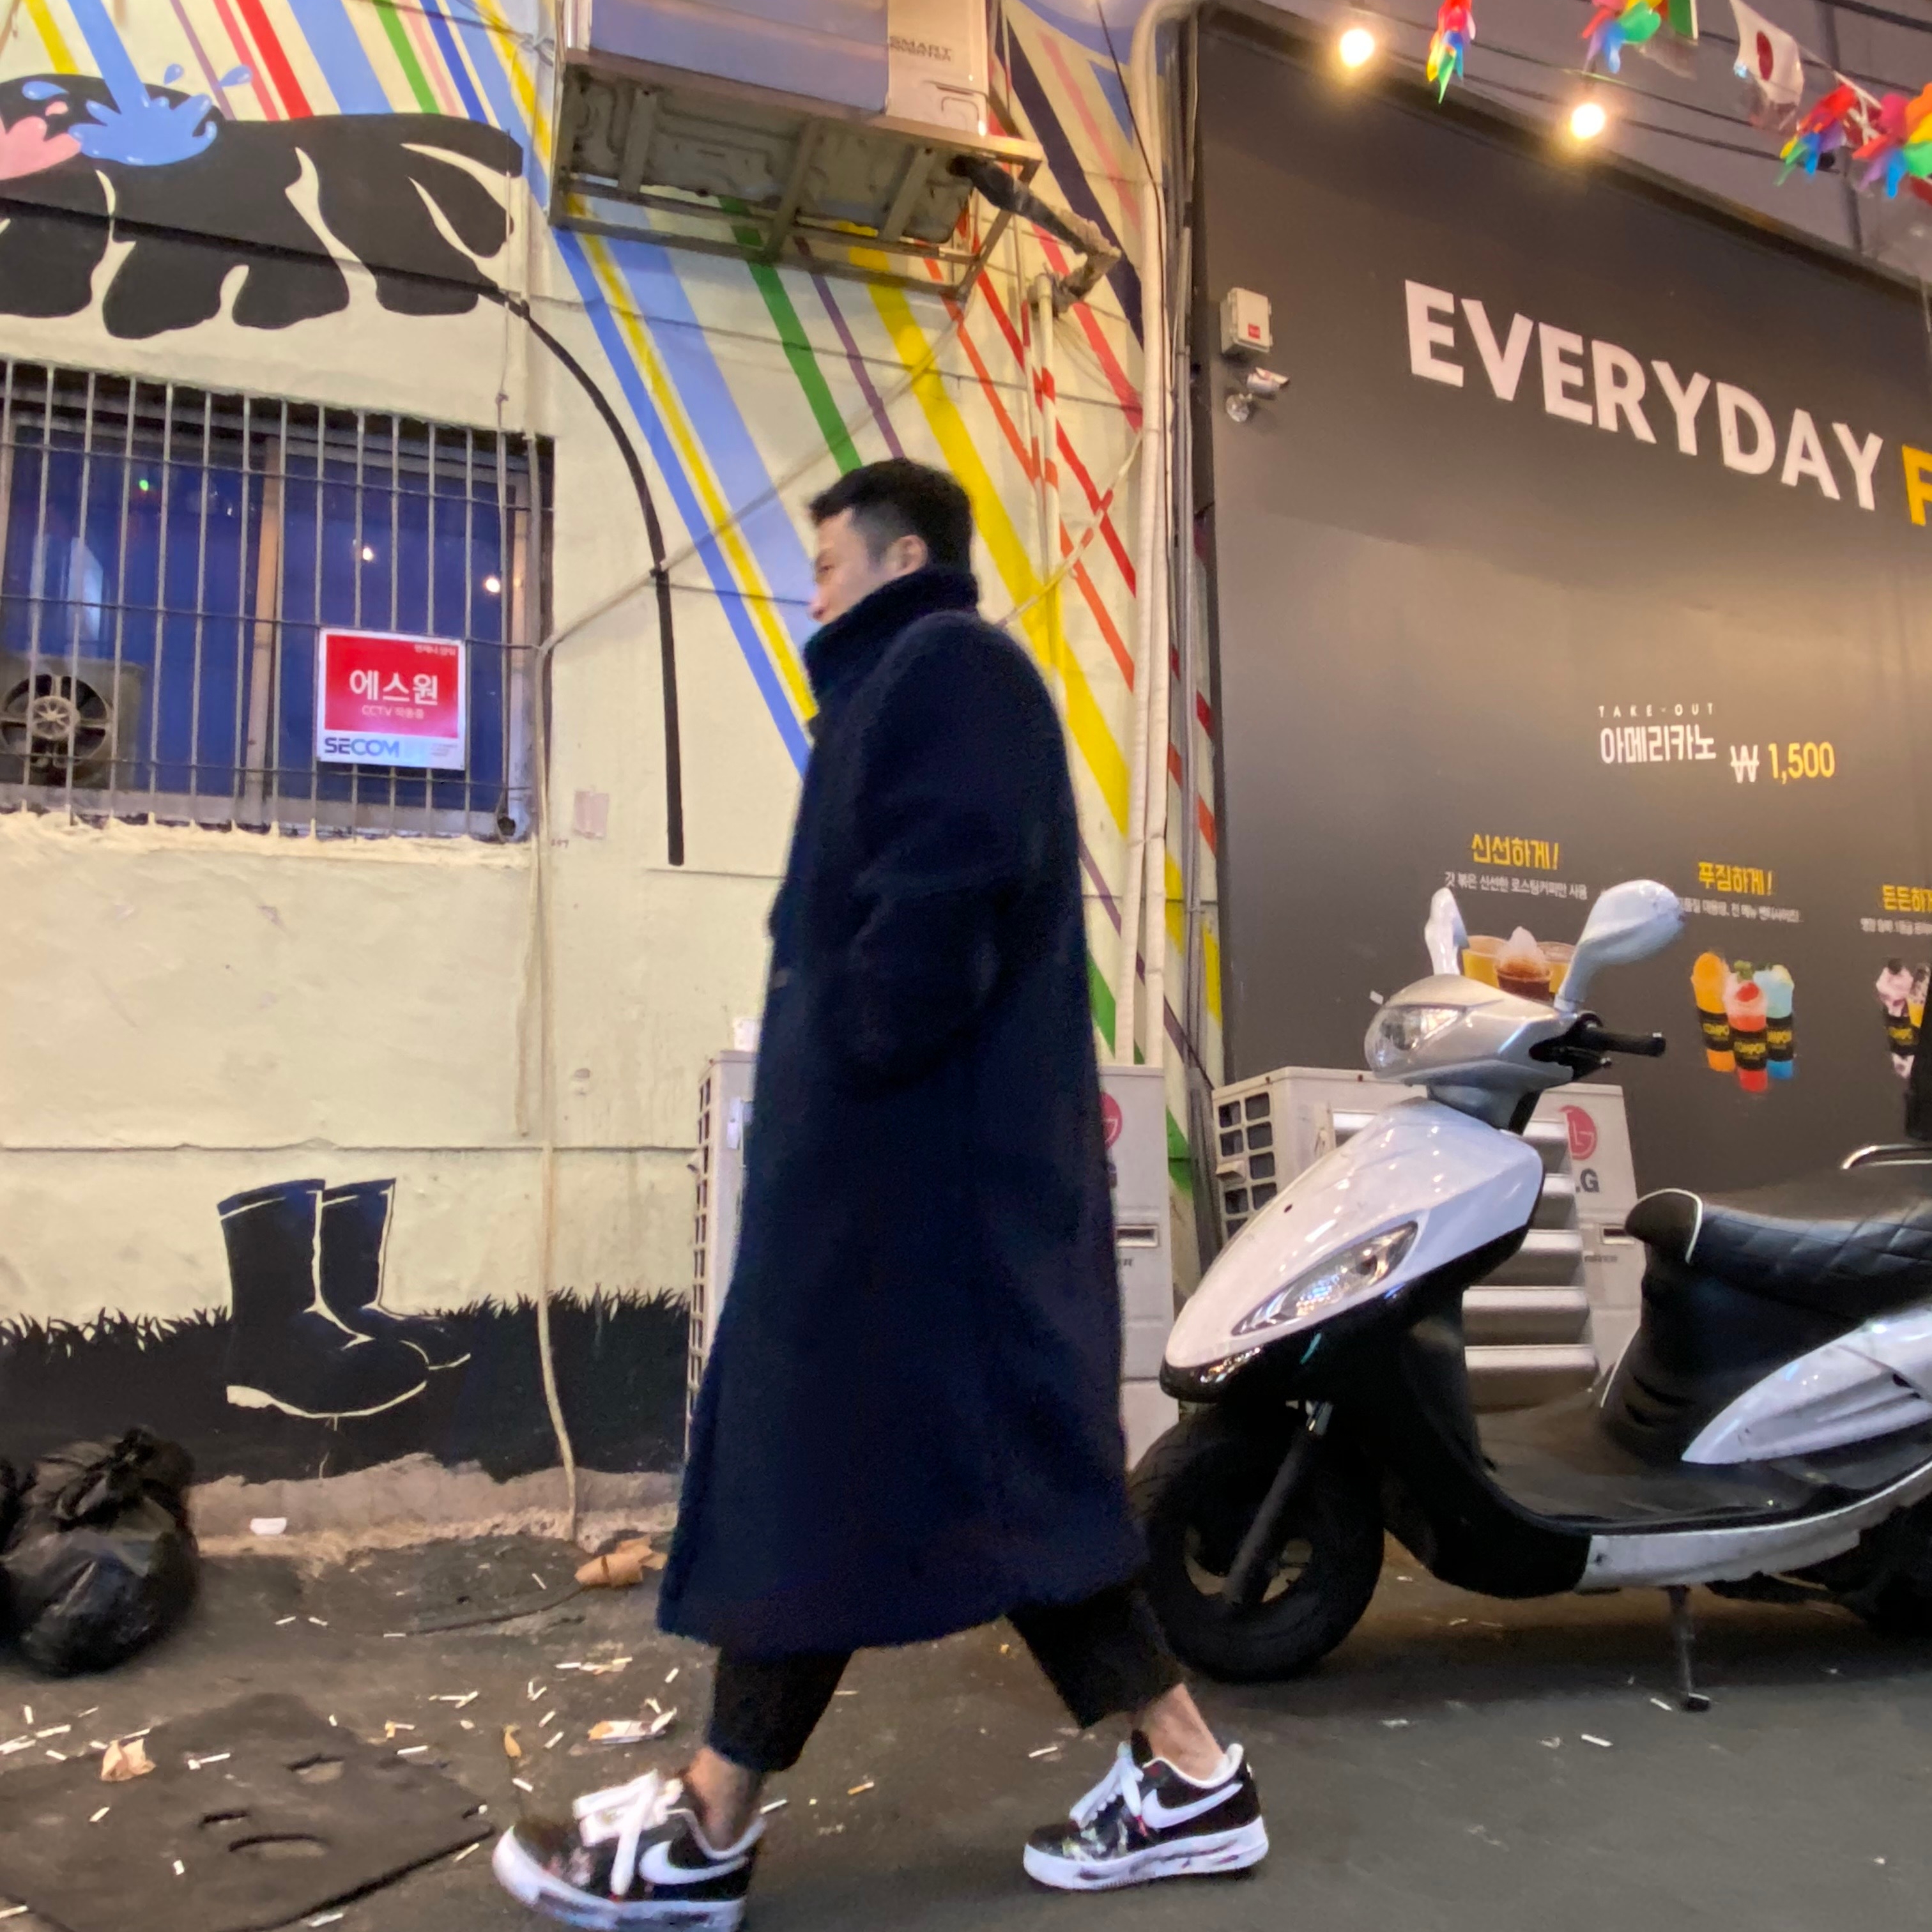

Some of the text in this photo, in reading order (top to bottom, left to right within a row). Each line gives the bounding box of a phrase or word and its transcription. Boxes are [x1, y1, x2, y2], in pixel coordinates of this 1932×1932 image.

[1405, 279, 1883, 510] EVERYDAY
[349, 670, 438, 705] 에스원
[362, 705, 392, 717] CCTV
[324, 737, 400, 758] SECOM
[1600, 724, 1717, 763] 아메리카노
[1768, 742, 1836, 785] 1,500
[1471, 834, 1560, 870] 신선하게!
[1698, 861, 1772, 896] 푸짐하게!
[1575, 1168, 1600, 1193] G
